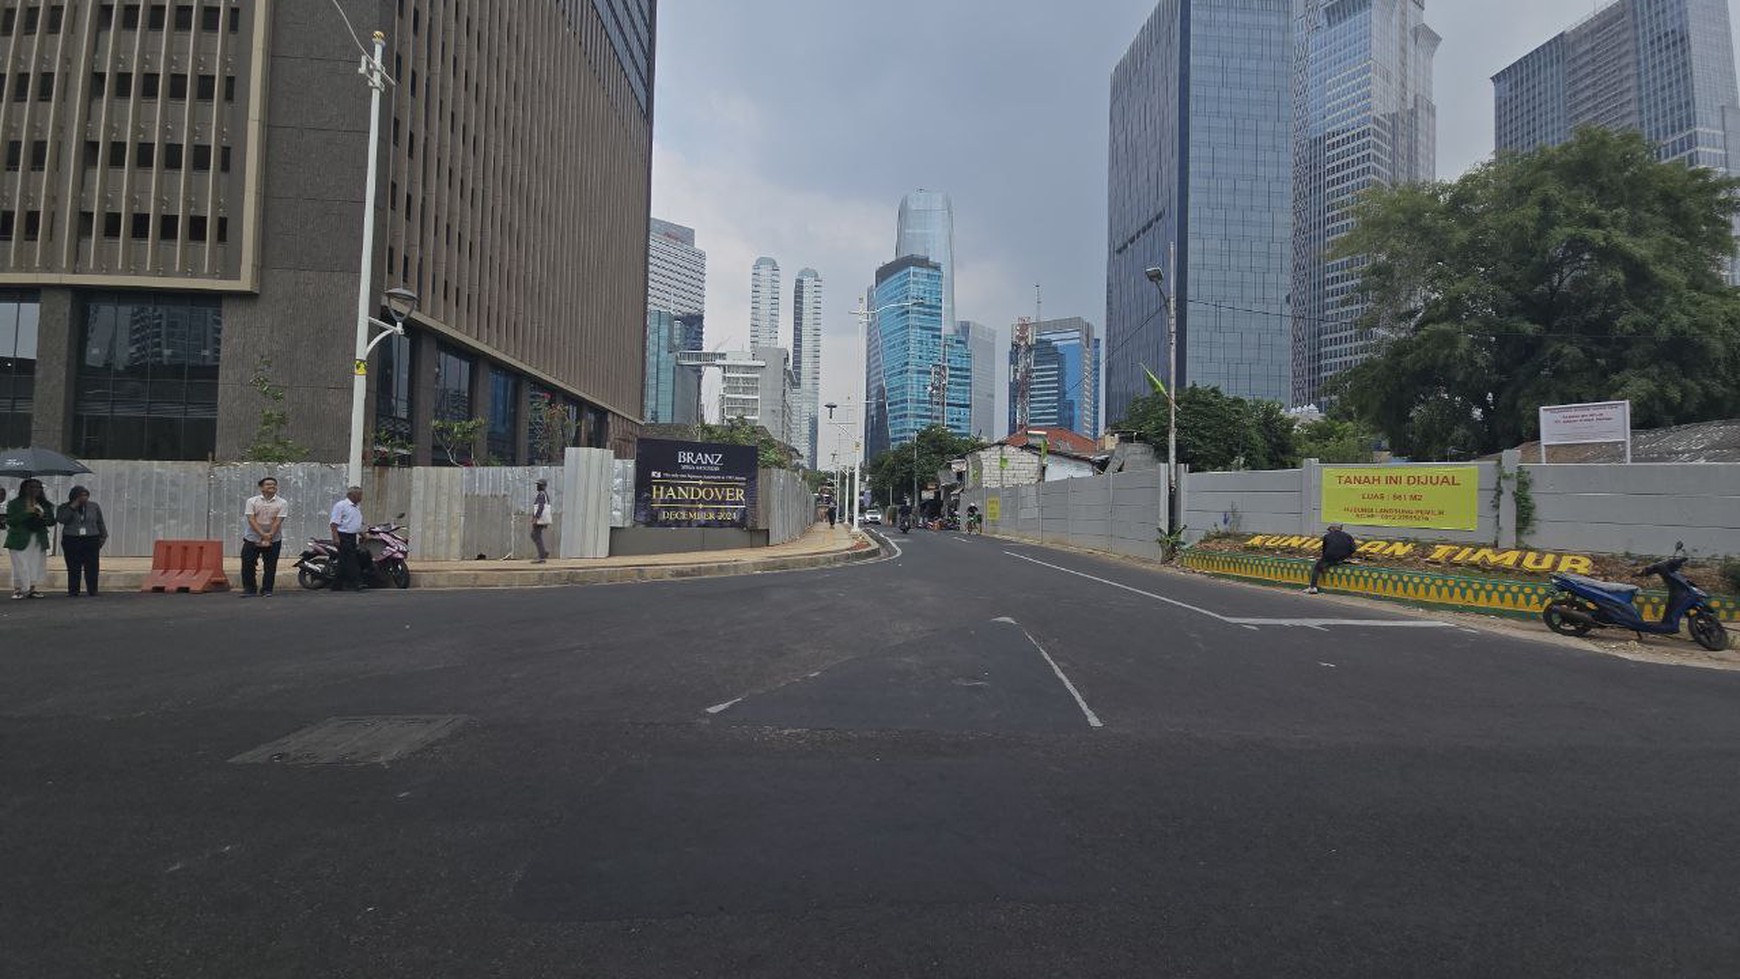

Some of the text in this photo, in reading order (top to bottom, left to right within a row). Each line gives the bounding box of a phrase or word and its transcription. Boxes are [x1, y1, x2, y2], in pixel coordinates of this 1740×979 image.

[678, 451, 724, 466] BRANZ
[1336, 475, 1461, 486] TANAH INI DIJUAL
[651, 485, 746, 502] HANDOVER
[1244, 535, 1593, 576] KUNIAN TIMUR
